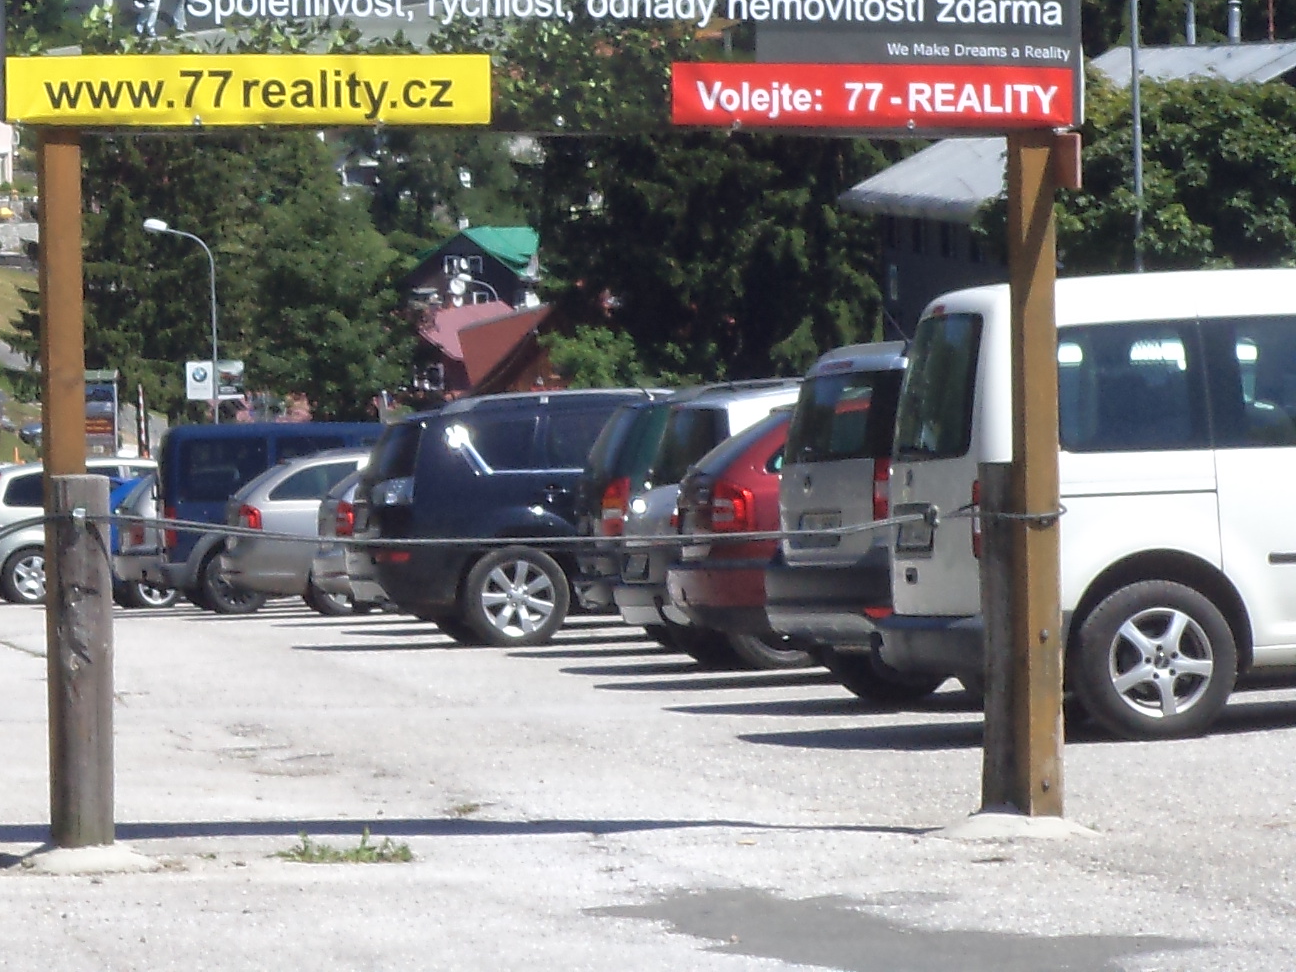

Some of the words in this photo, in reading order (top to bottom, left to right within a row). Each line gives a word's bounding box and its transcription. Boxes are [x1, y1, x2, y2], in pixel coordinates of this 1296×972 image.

[886, 42, 910, 57] We
[913, 43, 951, 57] Make
[954, 44, 1008, 58] Dreams
[1010, 47, 1021, 58] a
[1024, 45, 1071, 62] Reality
[44, 69, 454, 120] www.77reality.cz
[696, 80, 824, 119] Volejte:
